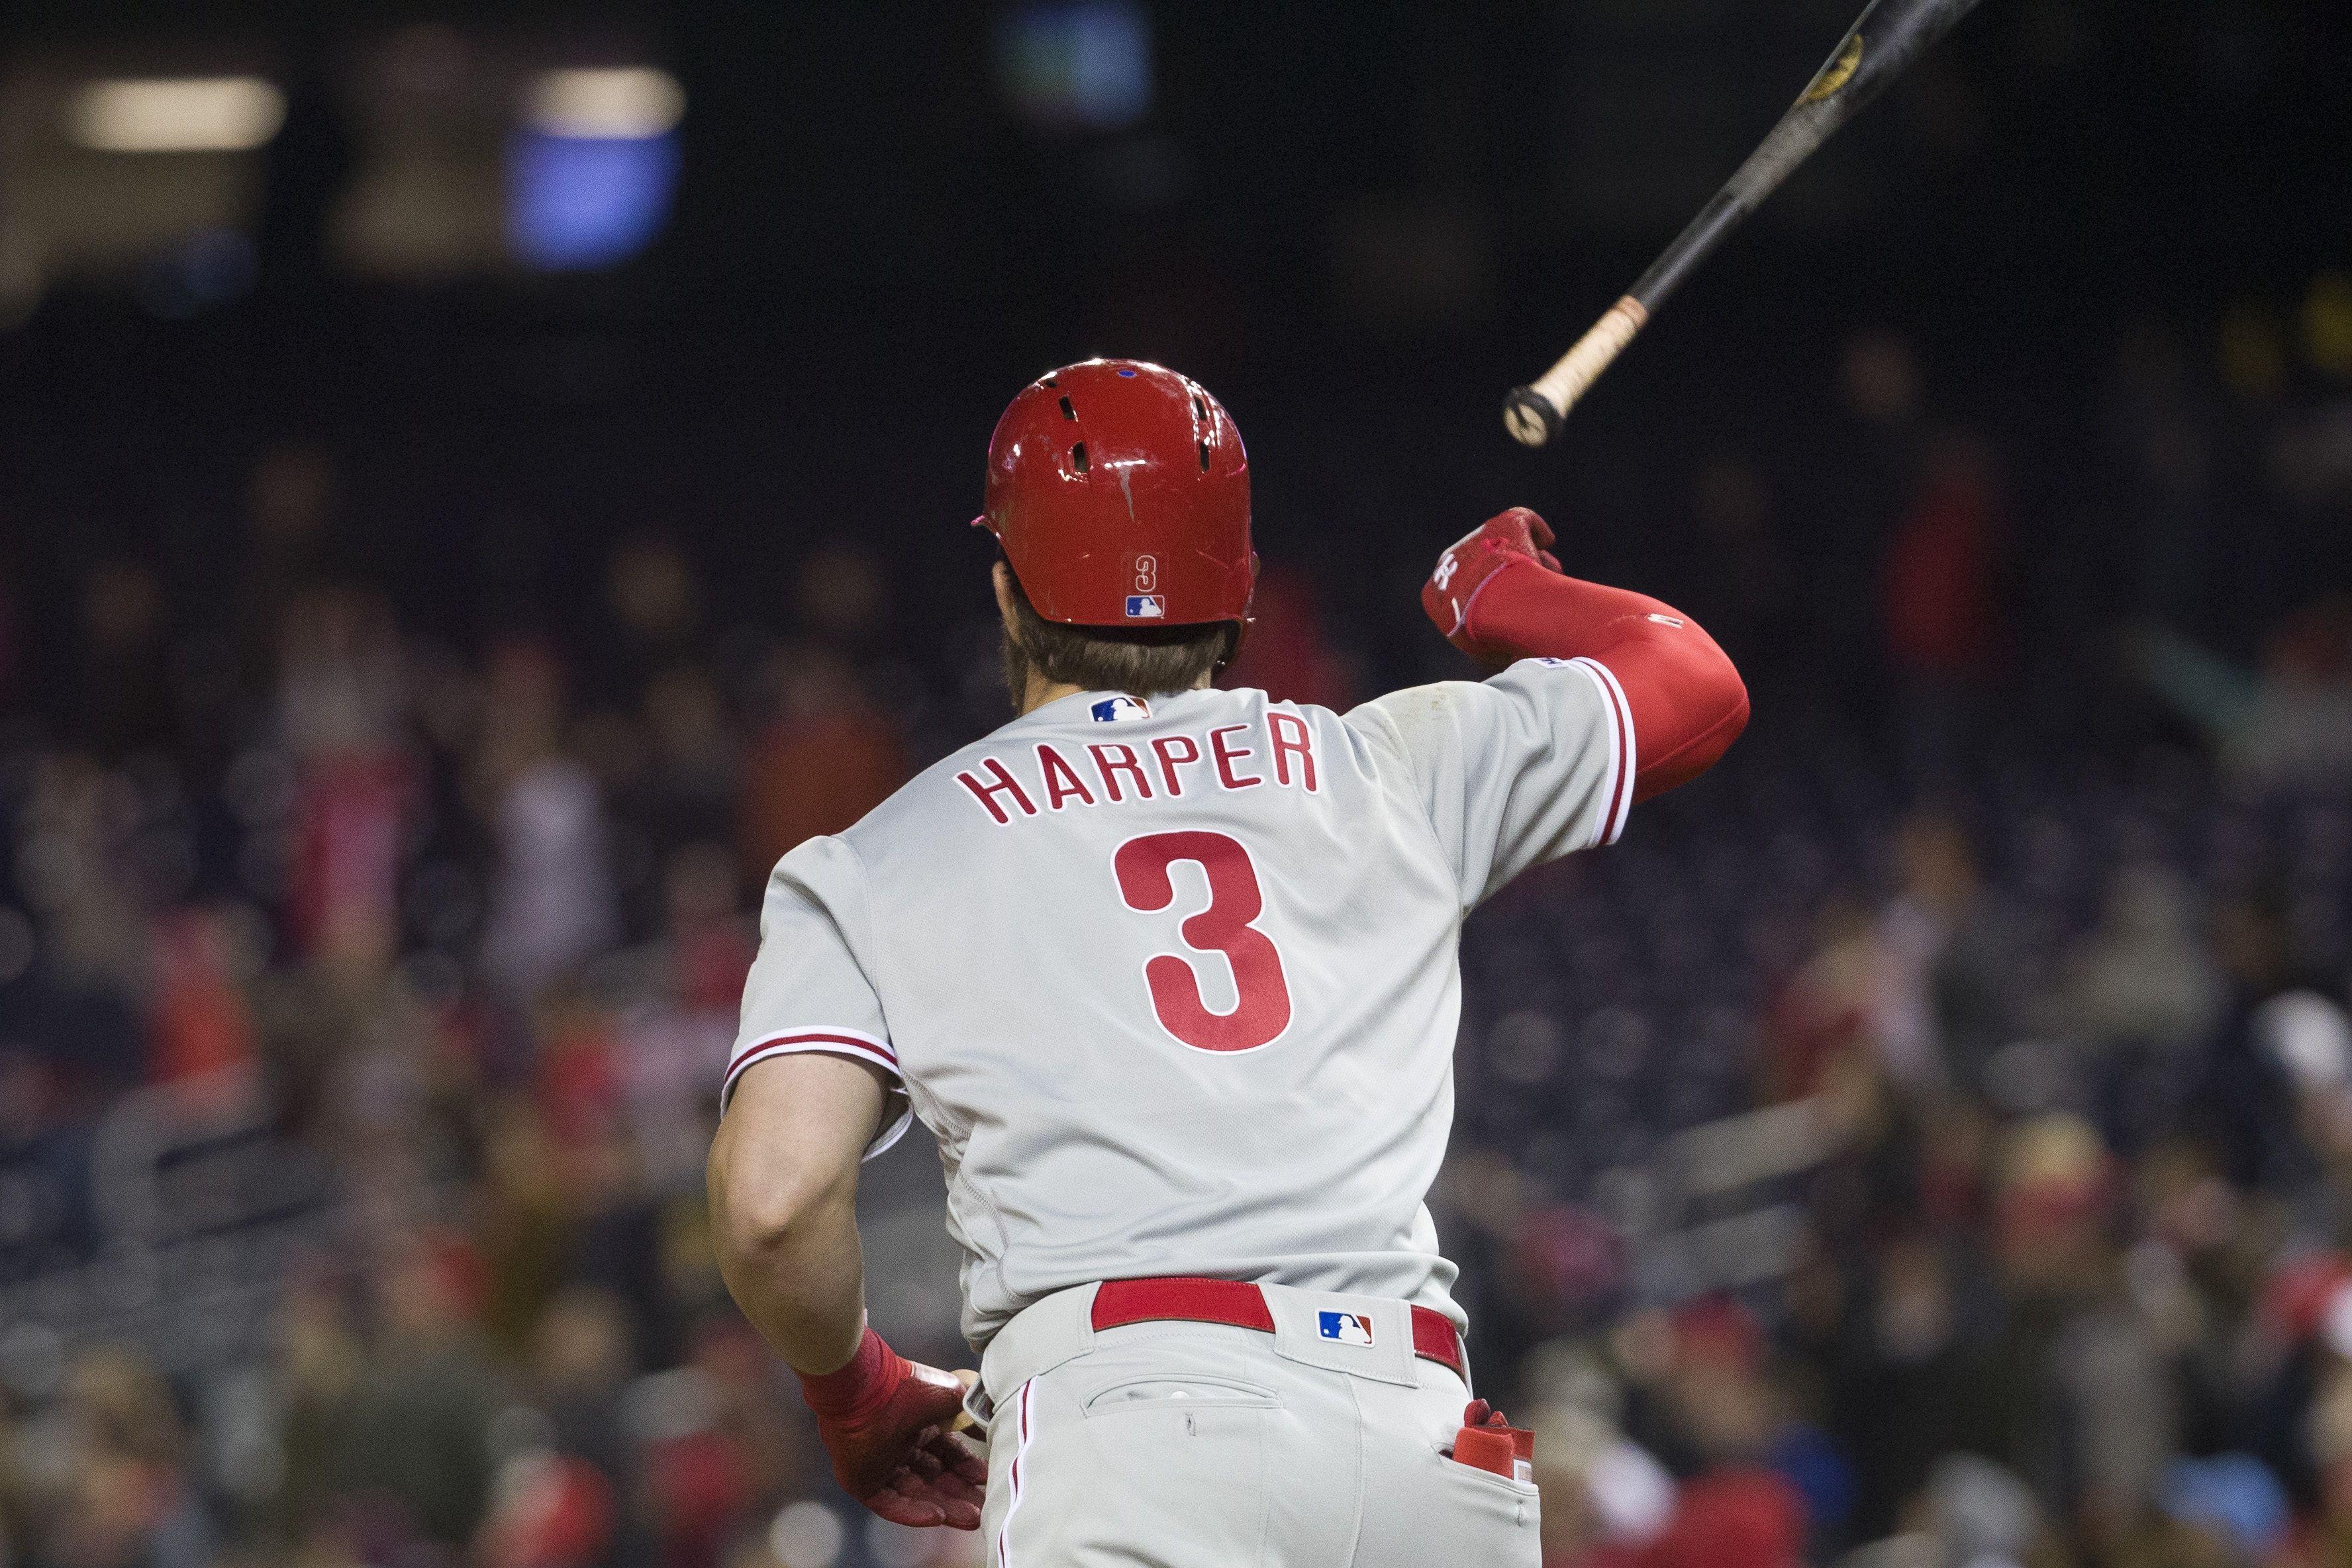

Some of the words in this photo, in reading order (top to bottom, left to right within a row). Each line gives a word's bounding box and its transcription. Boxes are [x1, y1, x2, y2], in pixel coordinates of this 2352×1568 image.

[1136, 555, 1156, 592] 3
[954, 710, 1319, 826] HARPER
[1112, 830, 1294, 1055] 3
